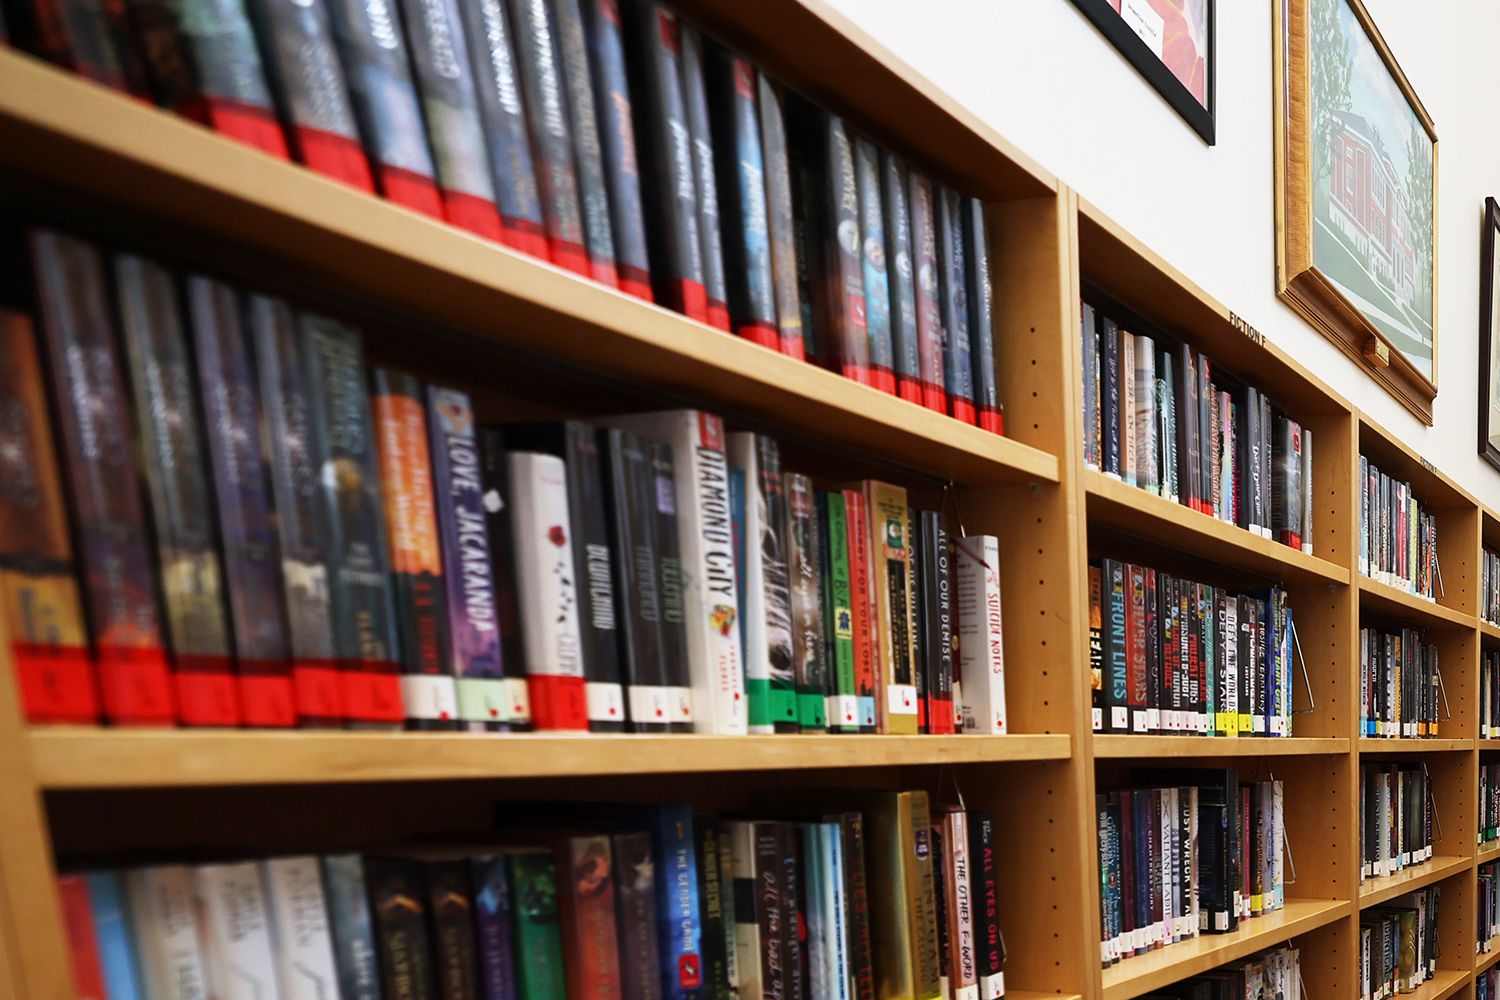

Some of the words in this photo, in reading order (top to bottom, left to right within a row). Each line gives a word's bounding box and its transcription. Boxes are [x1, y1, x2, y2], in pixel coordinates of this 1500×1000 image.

[1229, 311, 1260, 344] FICTION
[1260, 335, 1267, 347] F
[447, 436, 480, 498] LOVE,
[1419, 456, 1434, 474] FICTION
[697, 446, 729, 543] DIAMOND
[938, 529, 947, 547] ALL
[455, 504, 496, 632] JACARANDA
[857, 568, 866, 594] FOR
[939, 556, 948, 576] OF
[940, 579, 950, 610] OUR
[859, 601, 868, 637] YOUR
[986, 593, 1001, 637] SUICIDE
[1111, 592, 1127, 648] FRONT
[1132, 595, 1147, 649] SILVER
[1219, 610, 1227, 650] DEFY
[1227, 616, 1239, 643] DEFY
[941, 614, 951, 662] DEMISE
[861, 641, 870, 675] LOSS
[992, 639, 1003, 676] NOTES
[1112, 652, 1128, 700] LINES
[1227, 649, 1239, 669] THE
[1133, 654, 1148, 703] STARS
[1190, 680, 1199, 704] 1065
[1227, 674, 1239, 713] WORLDS
[1183, 802, 1191, 833] JUST
[983, 847, 994, 873] ALL
[1147, 829, 1155, 884] CHANTRESS
[1162, 823, 1172, 877] VALIANT
[1183, 839, 1191, 884] WRECK
[764, 872, 780, 903] all
[956, 857, 967, 881] THE
[957, 884, 970, 924] OTHER
[986, 879, 998, 918] EYES
[1184, 888, 1191, 900] IT
[767, 906, 783, 937] the
[988, 923, 999, 946] ON
[769, 938, 784, 976] bad
[960, 930, 974, 980] F-WORD
[990, 950, 1000, 971] US
[1384, 922, 1392, 979] IDENTICAL
